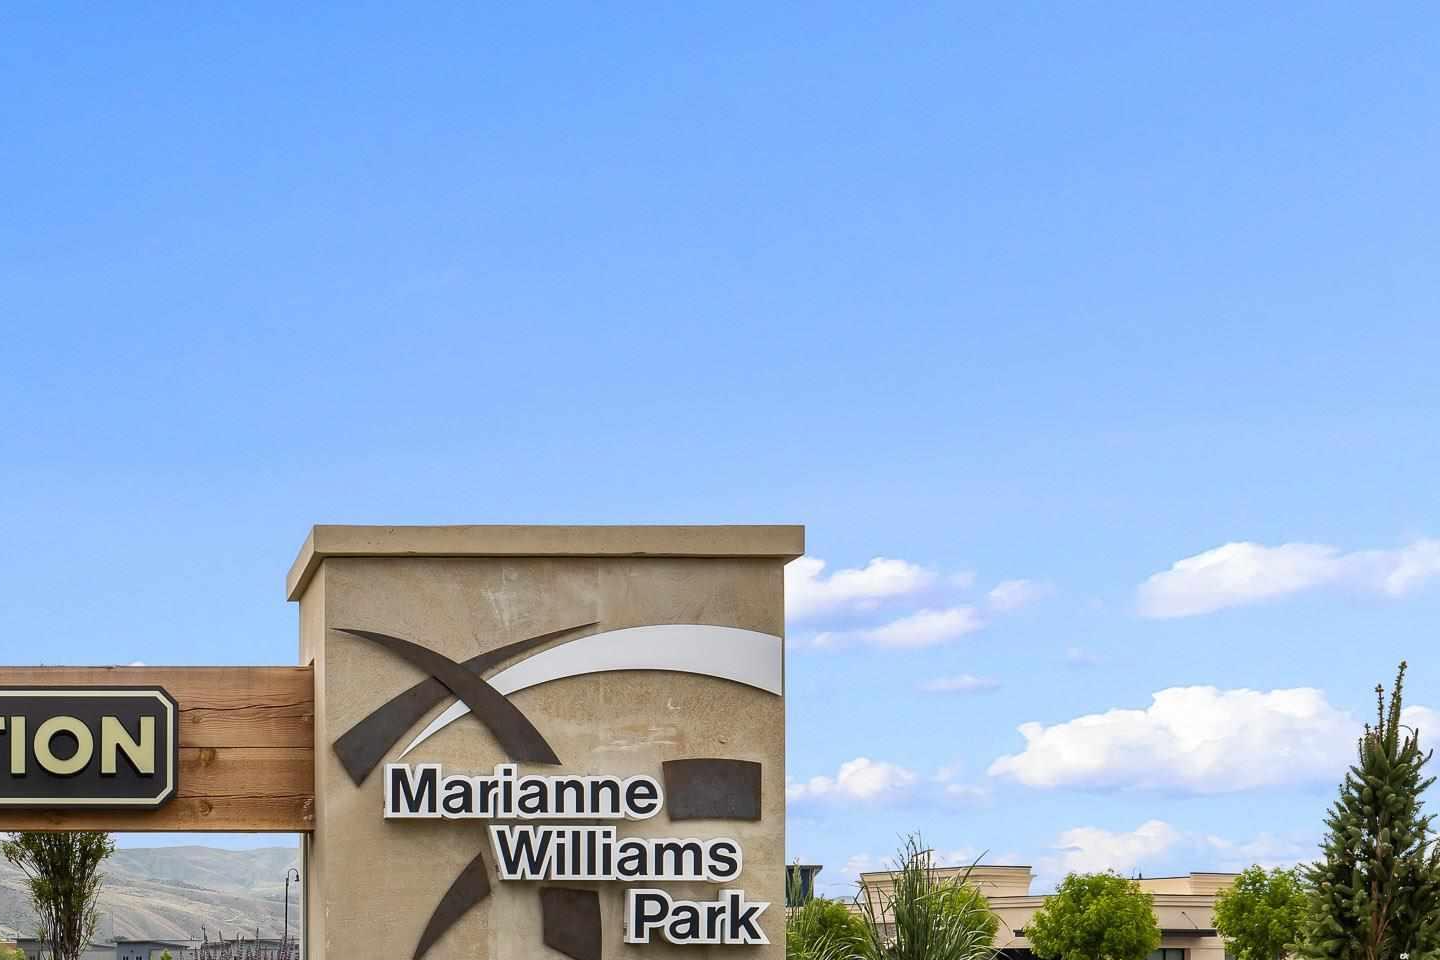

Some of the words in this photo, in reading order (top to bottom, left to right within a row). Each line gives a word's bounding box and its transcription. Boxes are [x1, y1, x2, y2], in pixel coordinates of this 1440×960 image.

[386, 764, 662, 818] Marianne
[491, 826, 742, 881] Williams
[628, 888, 769, 944] Park
